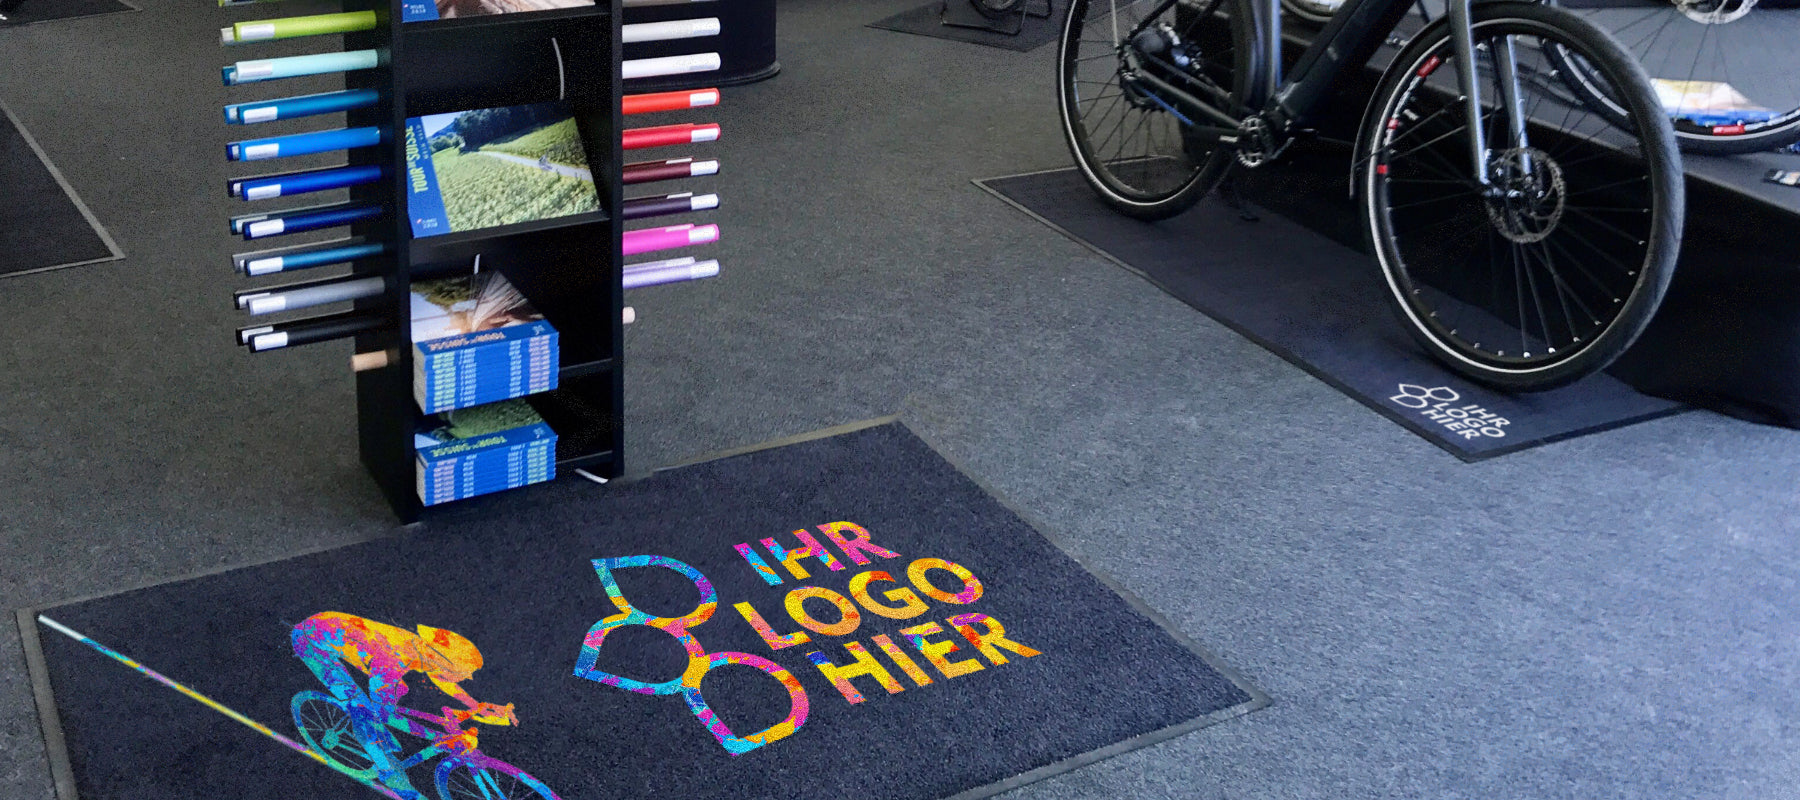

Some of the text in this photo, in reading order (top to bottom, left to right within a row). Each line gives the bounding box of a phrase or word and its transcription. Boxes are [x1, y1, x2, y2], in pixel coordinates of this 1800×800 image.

[405, 125, 420, 160] SUISSE
[410, 166, 429, 194] TOUR
[1421, 409, 1482, 440] HIER
[1432, 403, 1506, 438] LOGO
[1461, 404, 1511, 428] IHR
[732, 520, 902, 586] IHR
[732, 557, 984, 651] LOGO
[807, 612, 1042, 706] HIER
